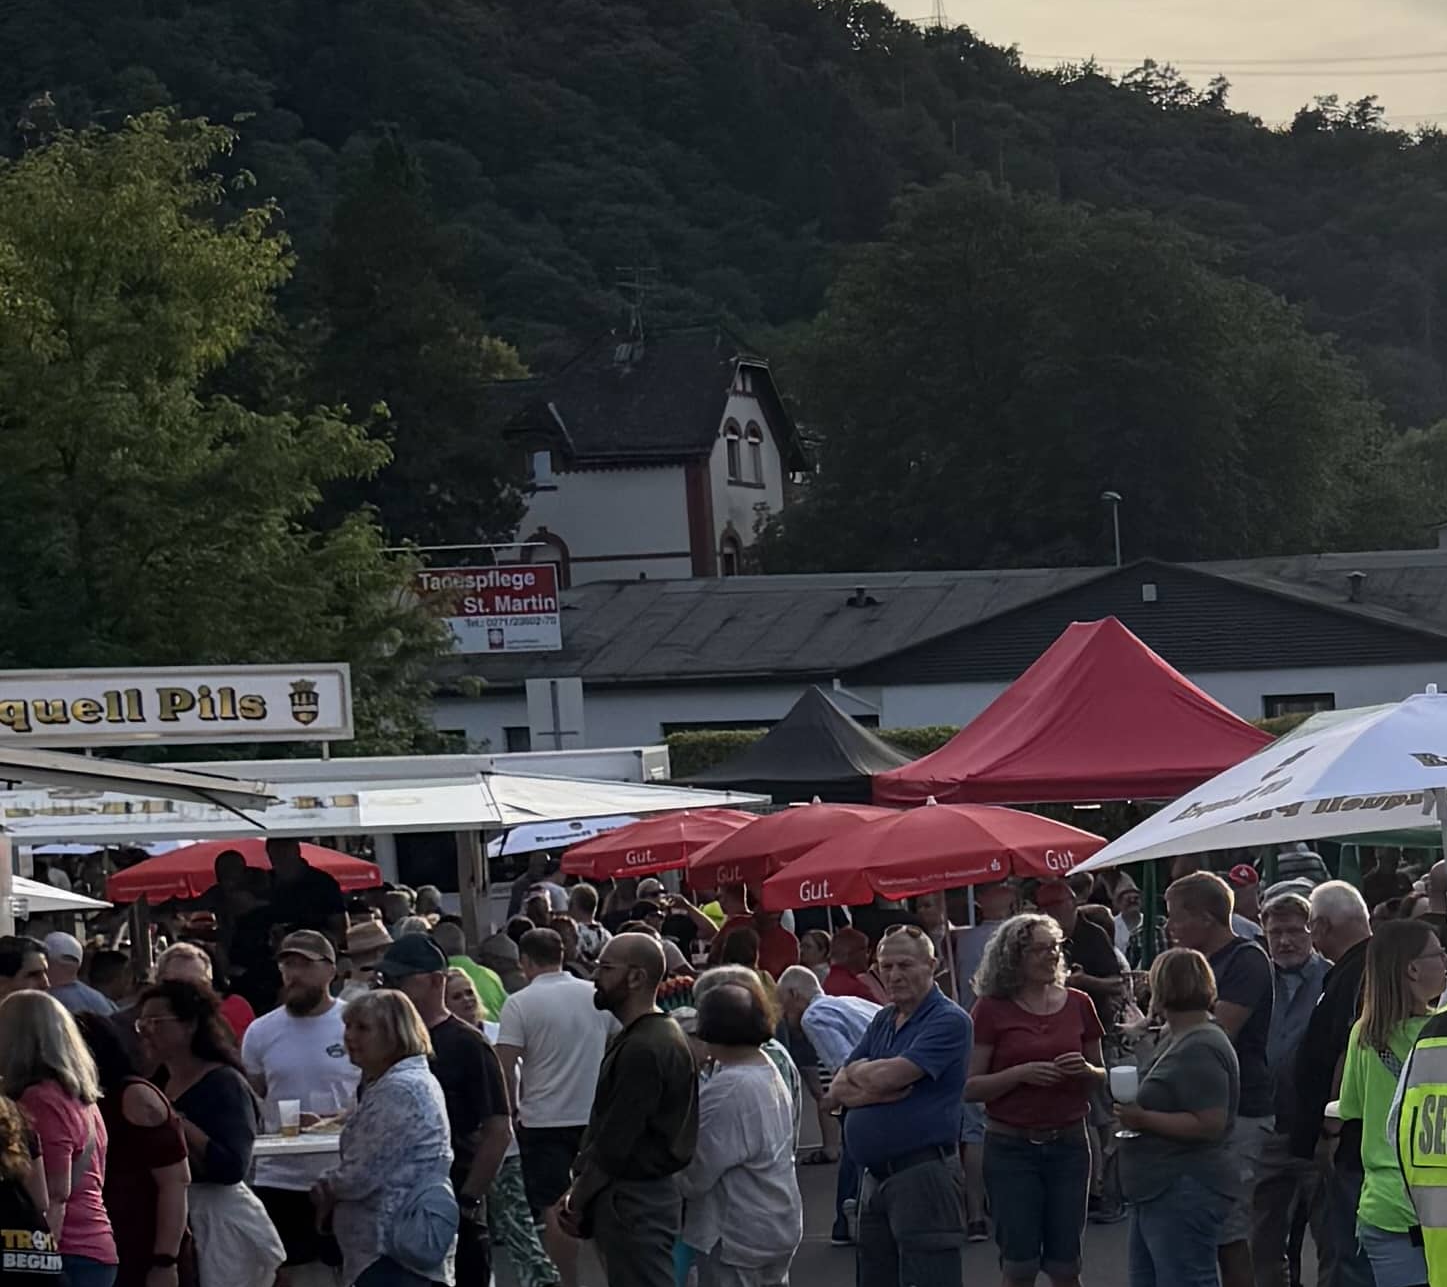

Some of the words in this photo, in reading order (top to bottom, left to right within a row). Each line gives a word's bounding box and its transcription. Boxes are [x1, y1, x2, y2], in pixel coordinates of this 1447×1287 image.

[463, 596, 490, 614] St.
[495, 593, 556, 614] Martin
[0, 687, 146, 733] quell
[156, 684, 267, 722] Pils
[625, 849, 657, 866] Gut.
[799, 879, 834, 902] Gut.
